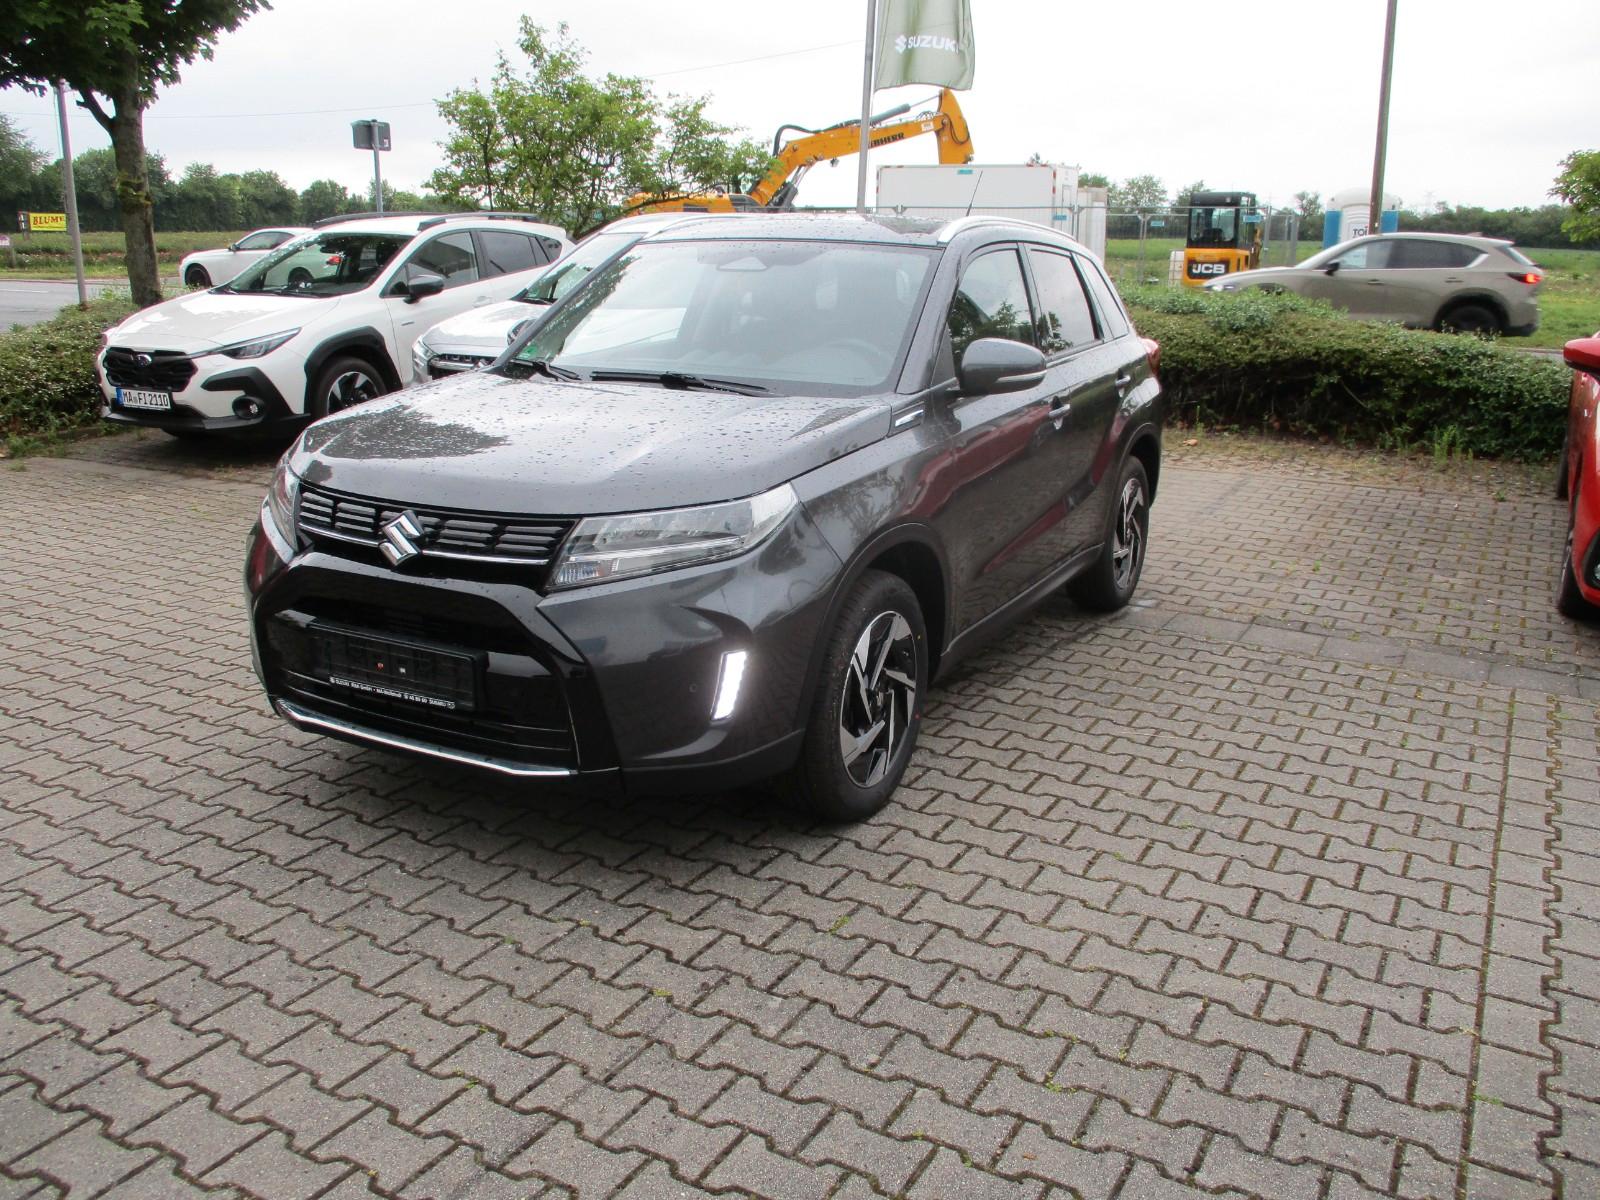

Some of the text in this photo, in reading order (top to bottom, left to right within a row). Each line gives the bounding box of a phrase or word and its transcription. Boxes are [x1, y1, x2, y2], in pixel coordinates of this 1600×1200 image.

[908, 35, 959, 54] SUZUKI
[1192, 263, 1225, 274] JCB
[122, 391, 133, 404] MA
